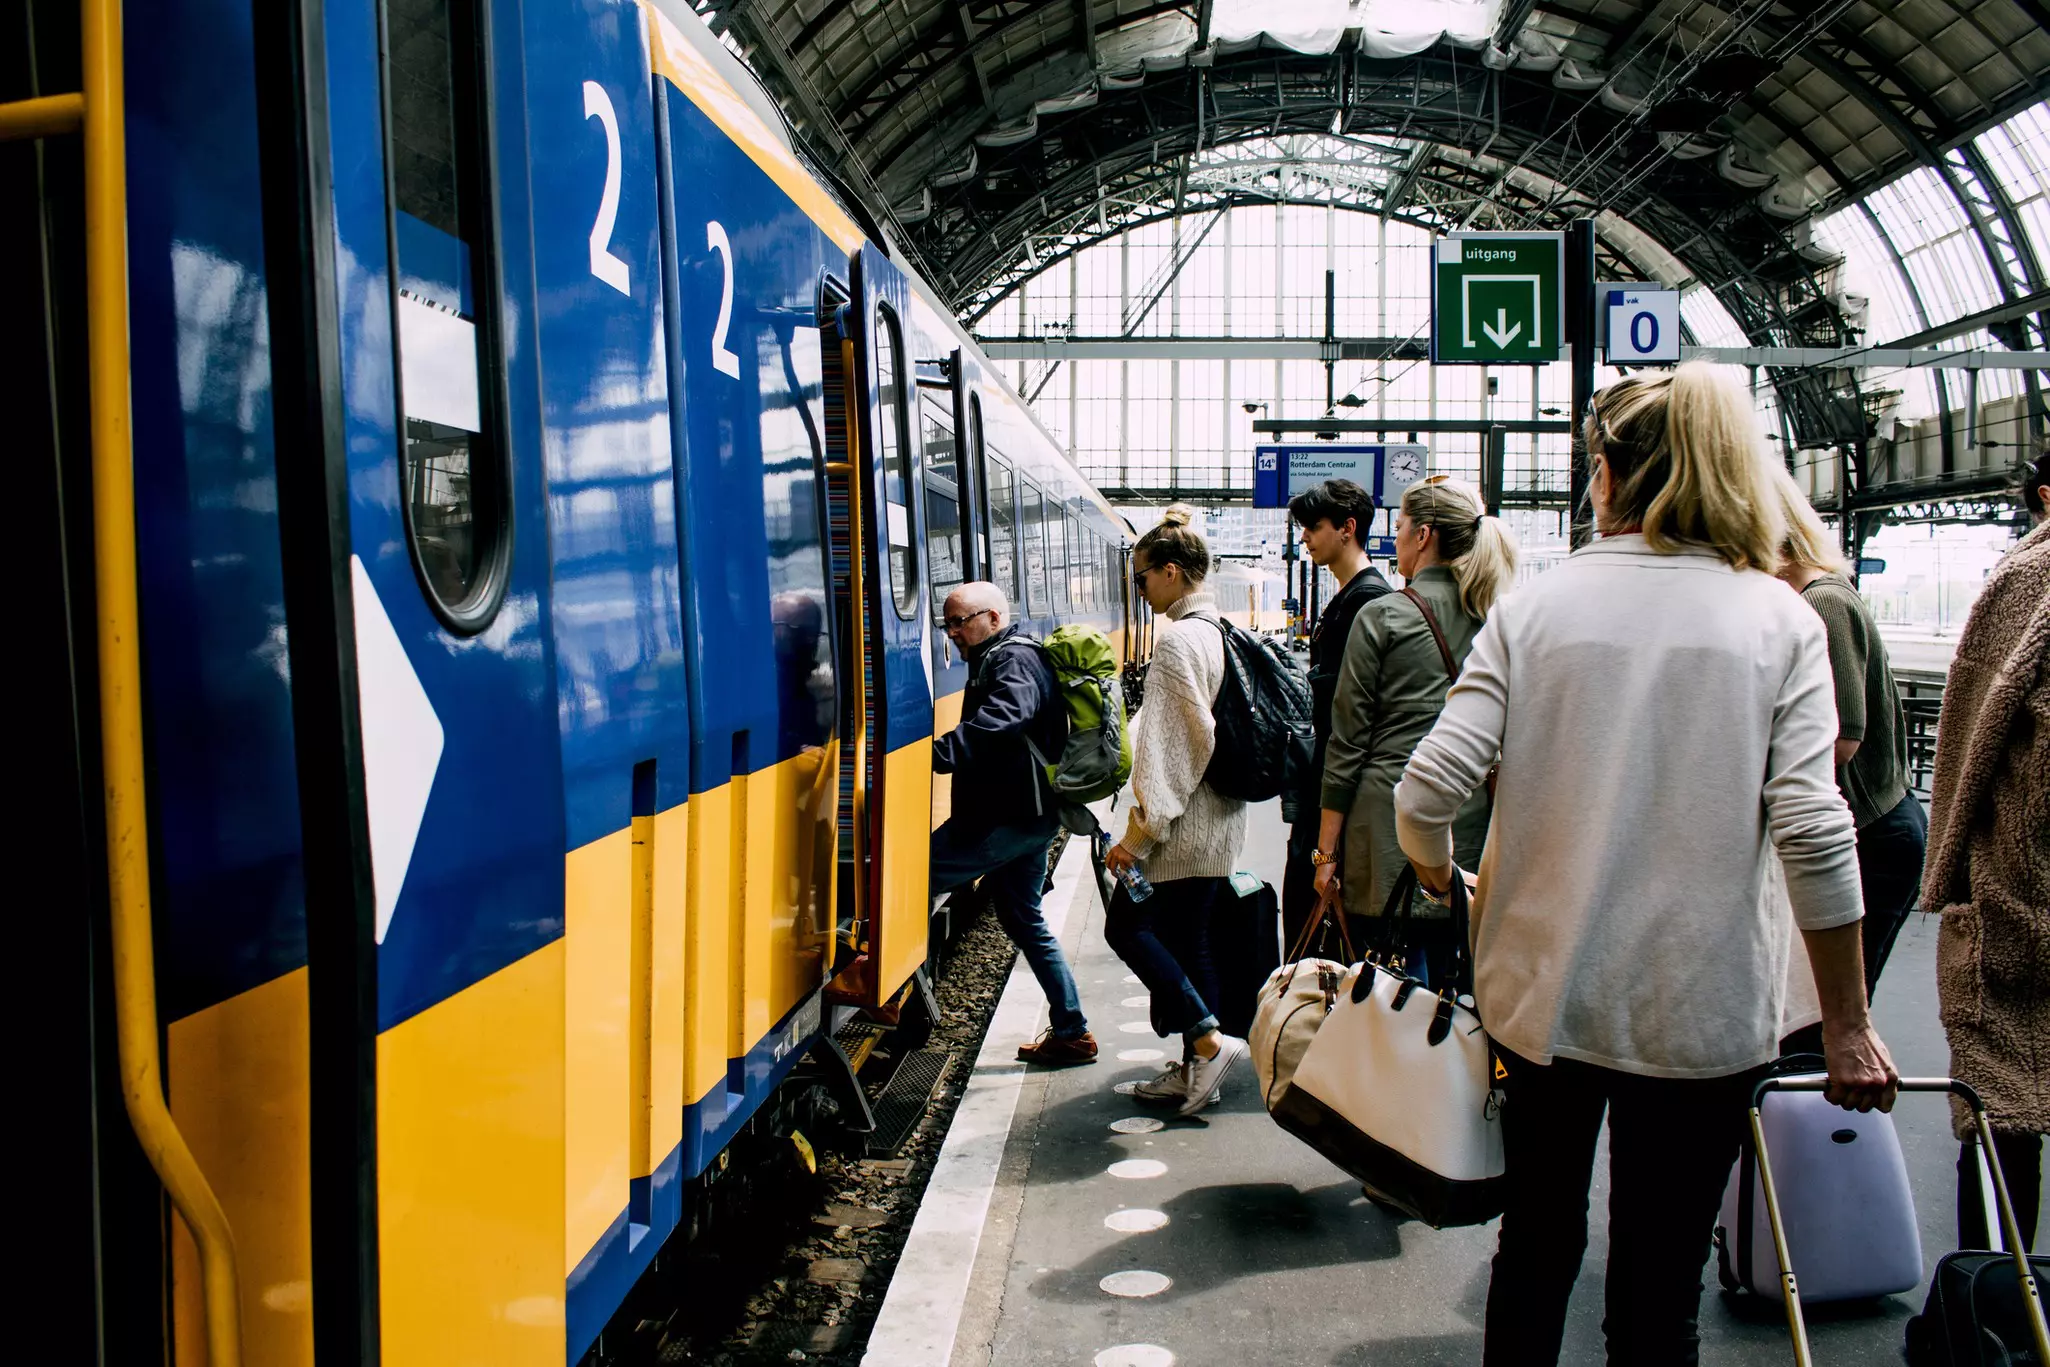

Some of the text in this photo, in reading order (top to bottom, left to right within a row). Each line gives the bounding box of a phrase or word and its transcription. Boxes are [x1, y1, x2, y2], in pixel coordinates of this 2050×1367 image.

[583, 80, 631, 297] 2
[1465, 247, 1517, 262] uitgang
[706, 220, 740, 381] 2
[1626, 297, 1639, 305] vak
[1630, 311, 1660, 353] 0
[1290, 461, 1356, 469] Rotterdam Centraal
